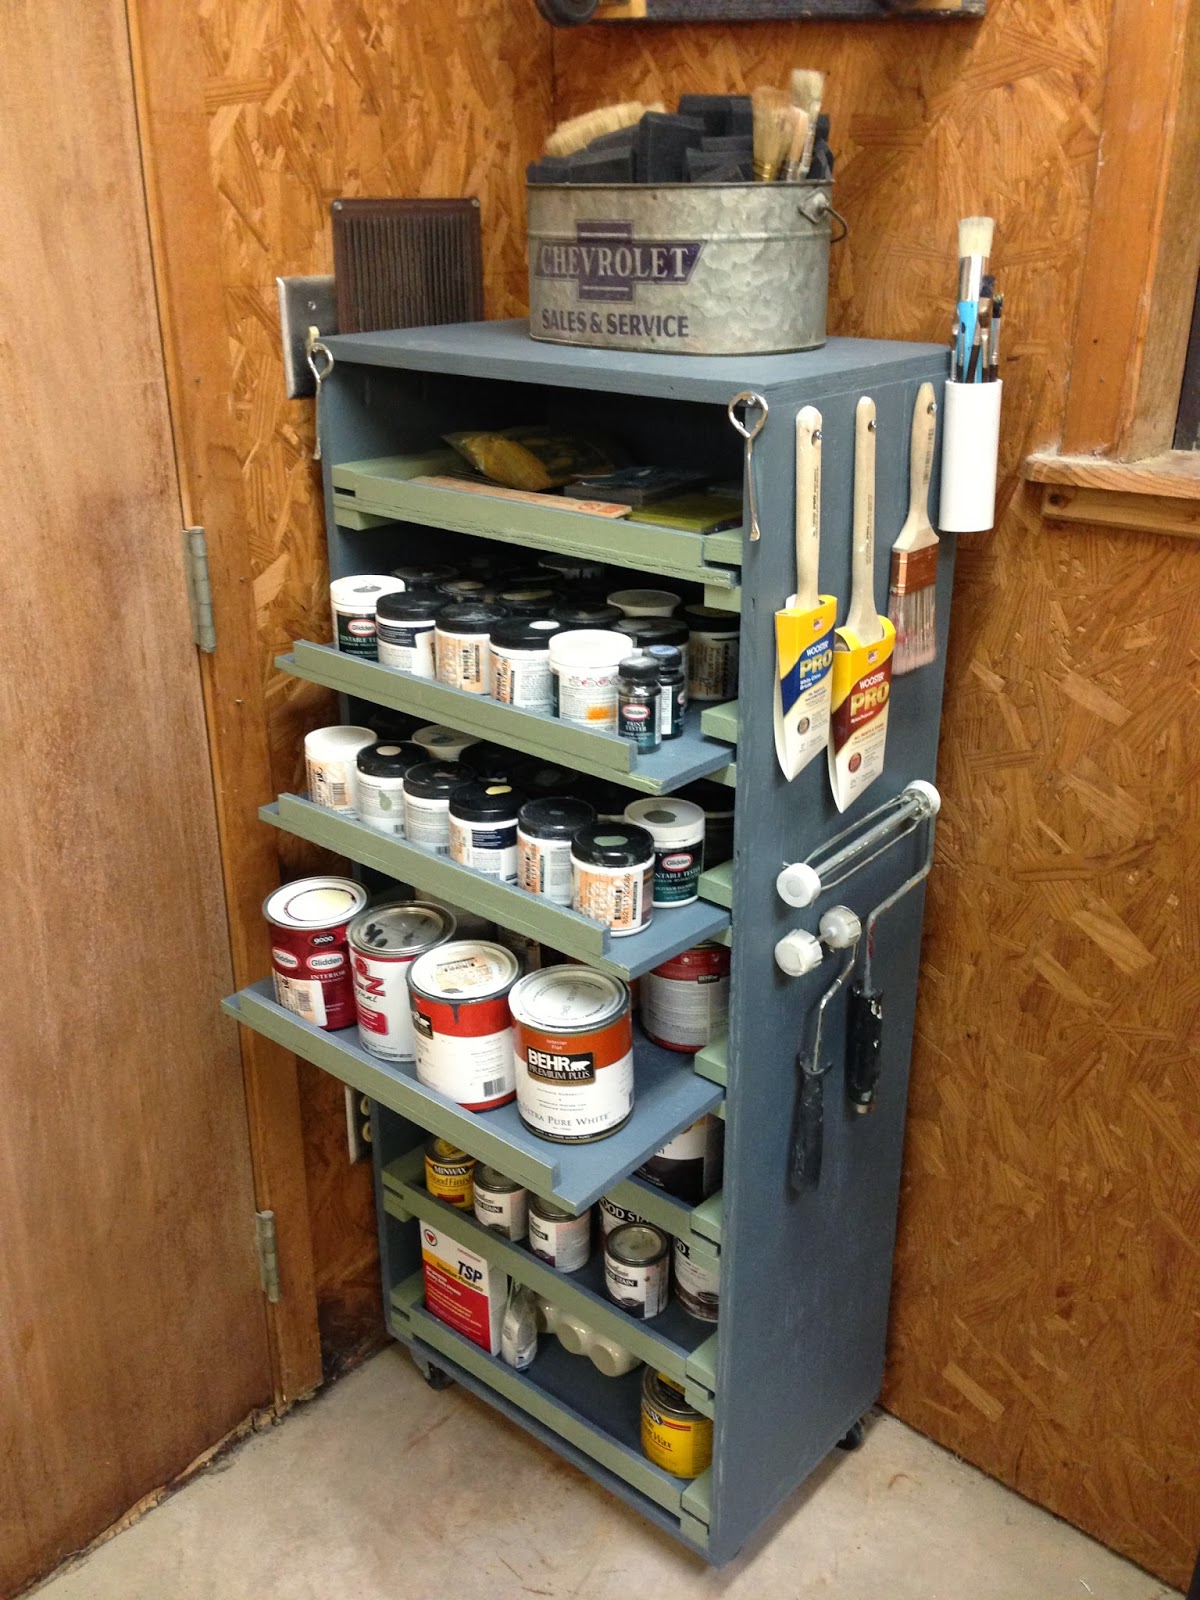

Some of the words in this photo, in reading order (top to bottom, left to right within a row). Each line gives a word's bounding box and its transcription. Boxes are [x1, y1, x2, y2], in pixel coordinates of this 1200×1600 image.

[540, 246, 689, 278] CHEVROLET
[541, 308, 587, 333] SALES
[590, 312, 603, 334] &
[606, 312, 689, 337] SERVICE
[806, 640, 829, 657] WOOSTER
[800, 649, 833, 679] PRO
[859, 671, 886, 690] WOOSTER
[850, 681, 890, 717] PRO
[313, 935, 334, 945] 9000
[311, 956, 342, 967] Glidden
[310, 970, 346, 979] INTERIOR
[528, 1048, 571, 1072] BEHR
[529, 1064, 567, 1080] PREMIUM
[568, 1070, 591, 1080] PLUS
[547, 1115, 573, 1127] PURE
[575, 1113, 608, 1126] WHITE
[458, 1260, 483, 1283] TSP
